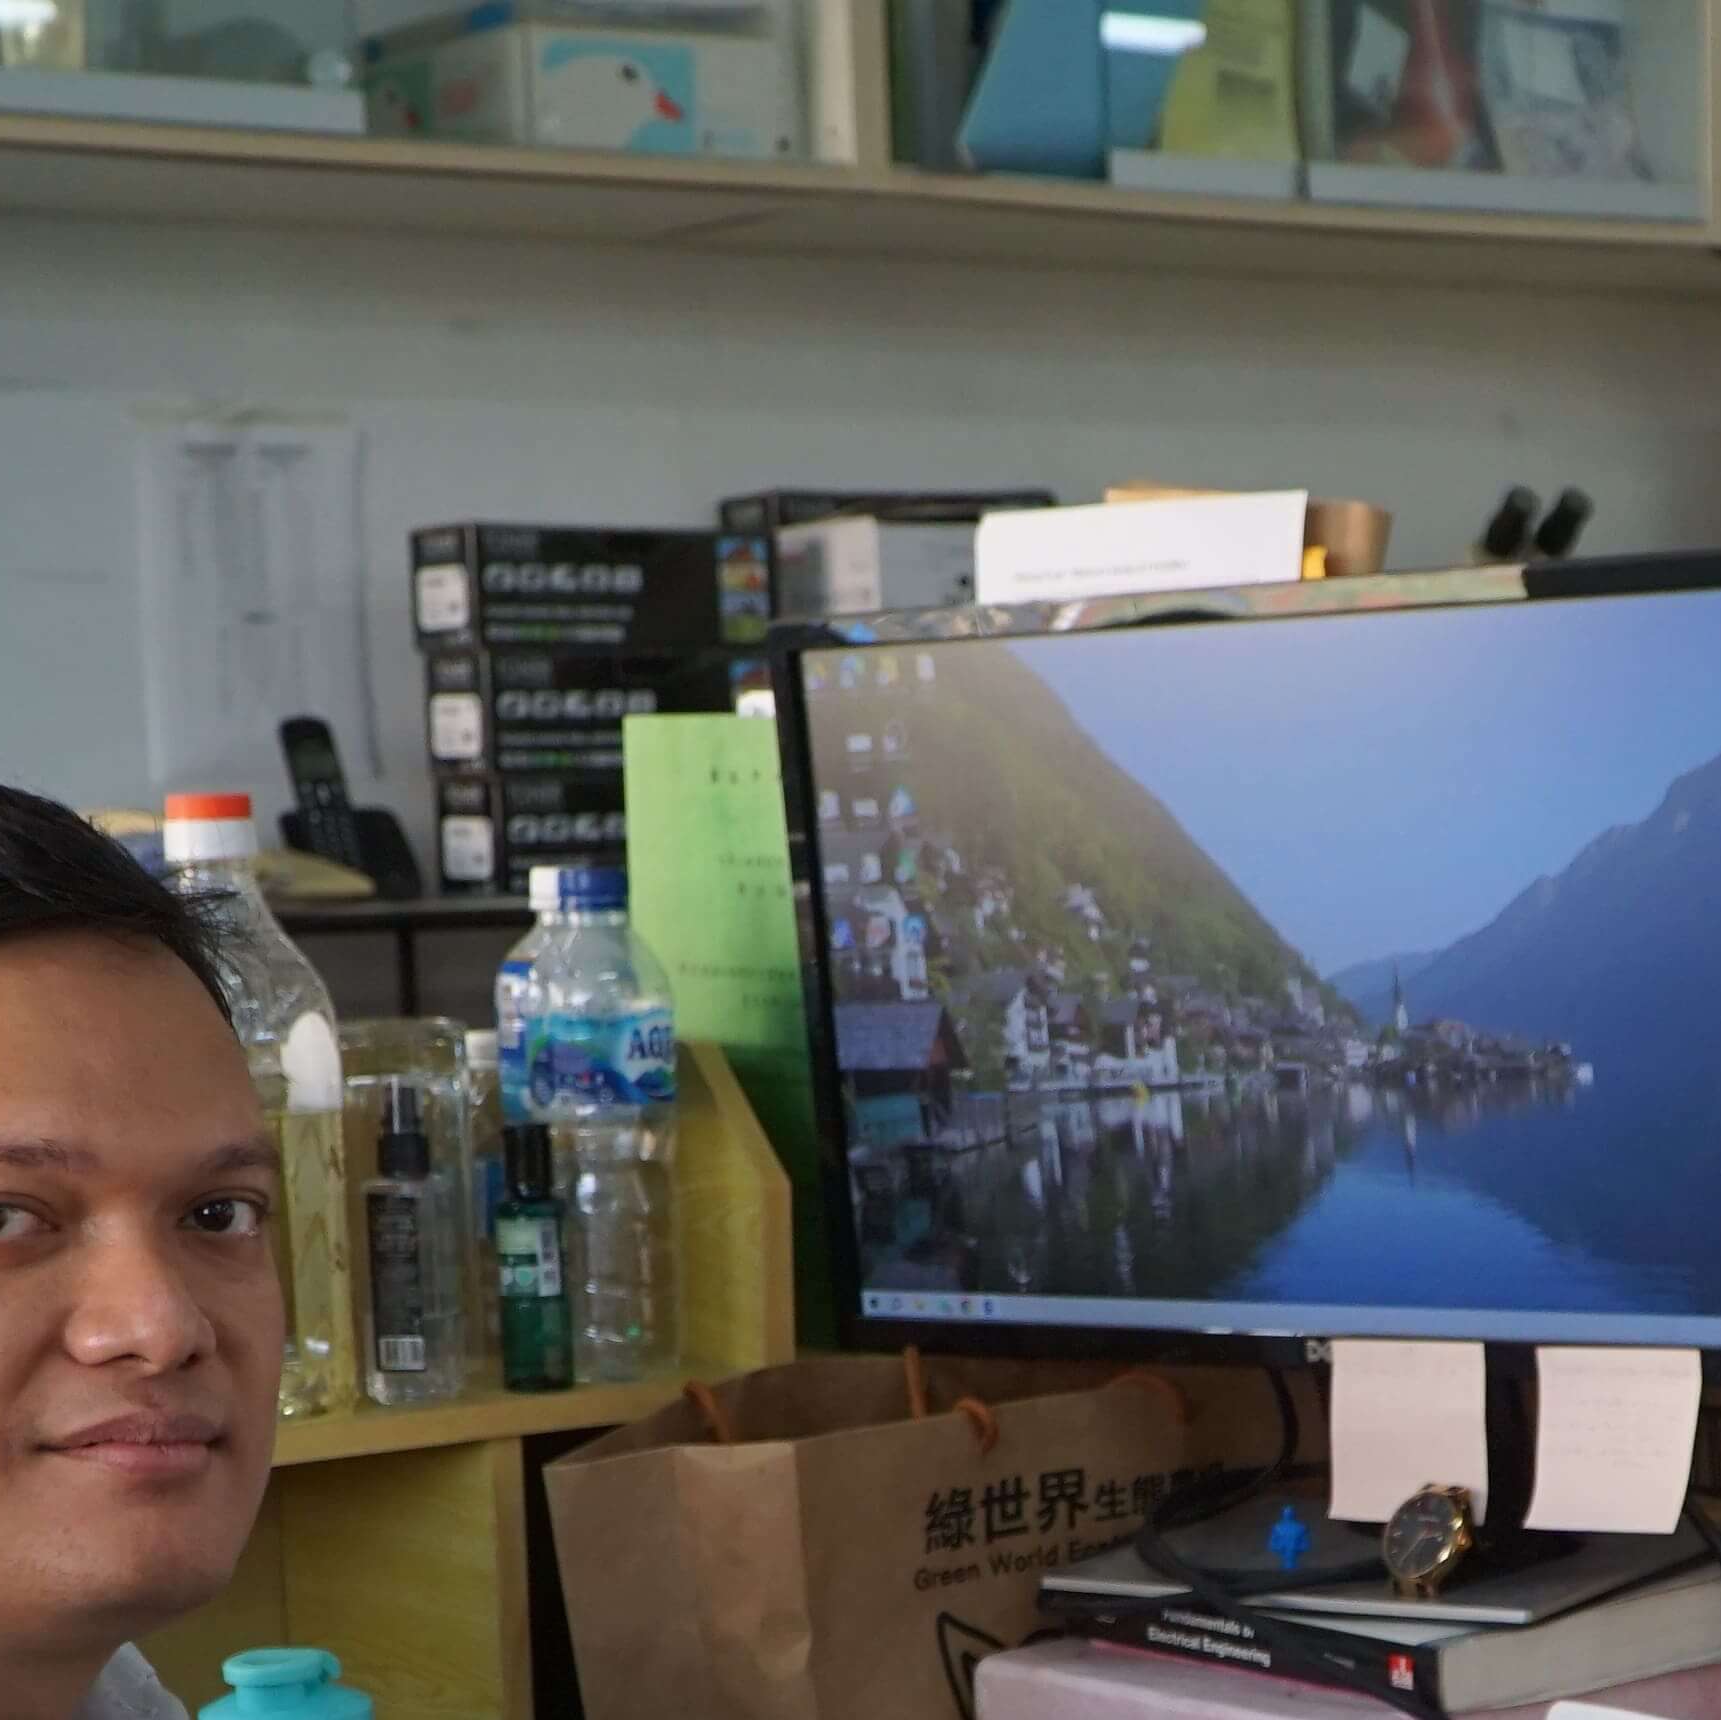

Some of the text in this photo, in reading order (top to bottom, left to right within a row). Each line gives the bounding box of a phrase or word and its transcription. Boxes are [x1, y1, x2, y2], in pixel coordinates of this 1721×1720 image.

[914, 1565, 980, 1592] Green
[989, 1548, 1059, 1575] World
[1146, 1624, 1272, 1668] Electrical Engineering
